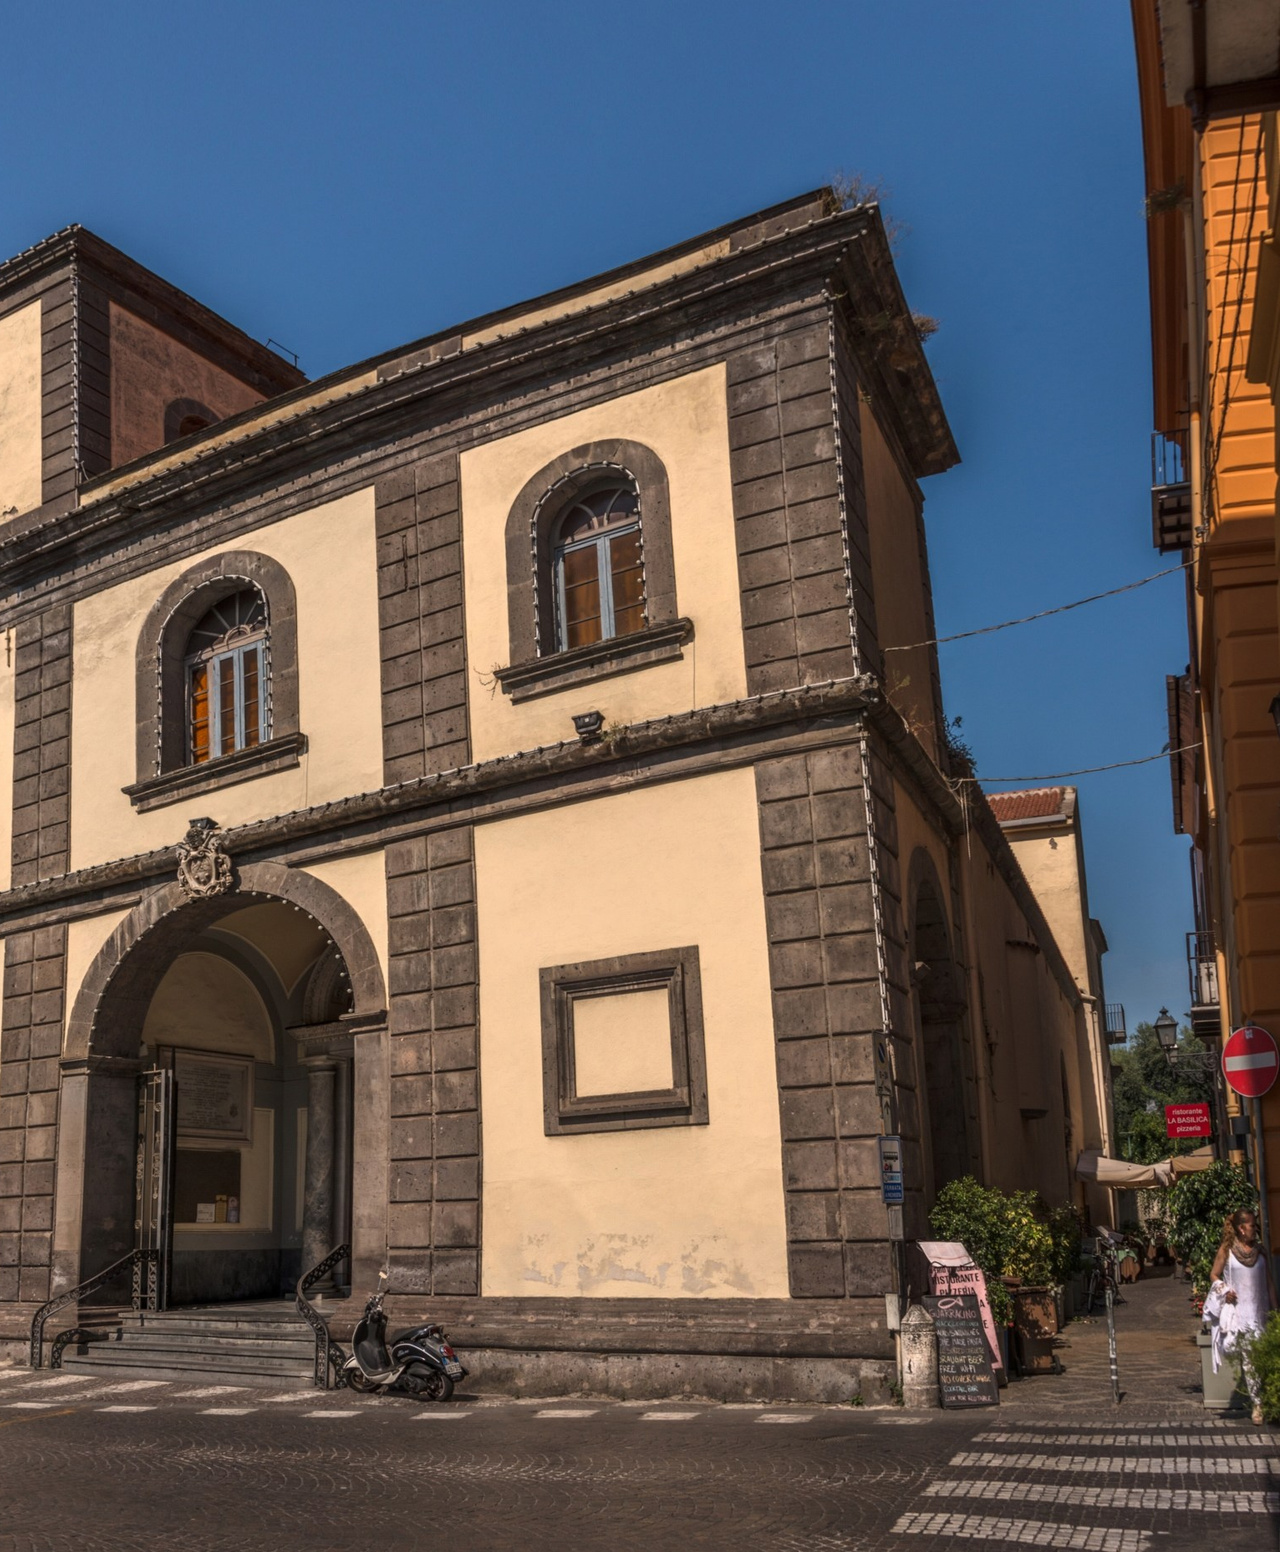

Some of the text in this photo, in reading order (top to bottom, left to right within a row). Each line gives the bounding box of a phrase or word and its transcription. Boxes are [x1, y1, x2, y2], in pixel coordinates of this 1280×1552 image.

[1177, 1116, 1208, 1124] BASILICA
[1176, 1125, 1202, 1133] pizzeria
[967, 1355, 985, 1364] BEER
[939, 1365, 957, 1374] FREE
[941, 1375, 951, 1384] NO
[951, 1375, 972, 1384] COVER
